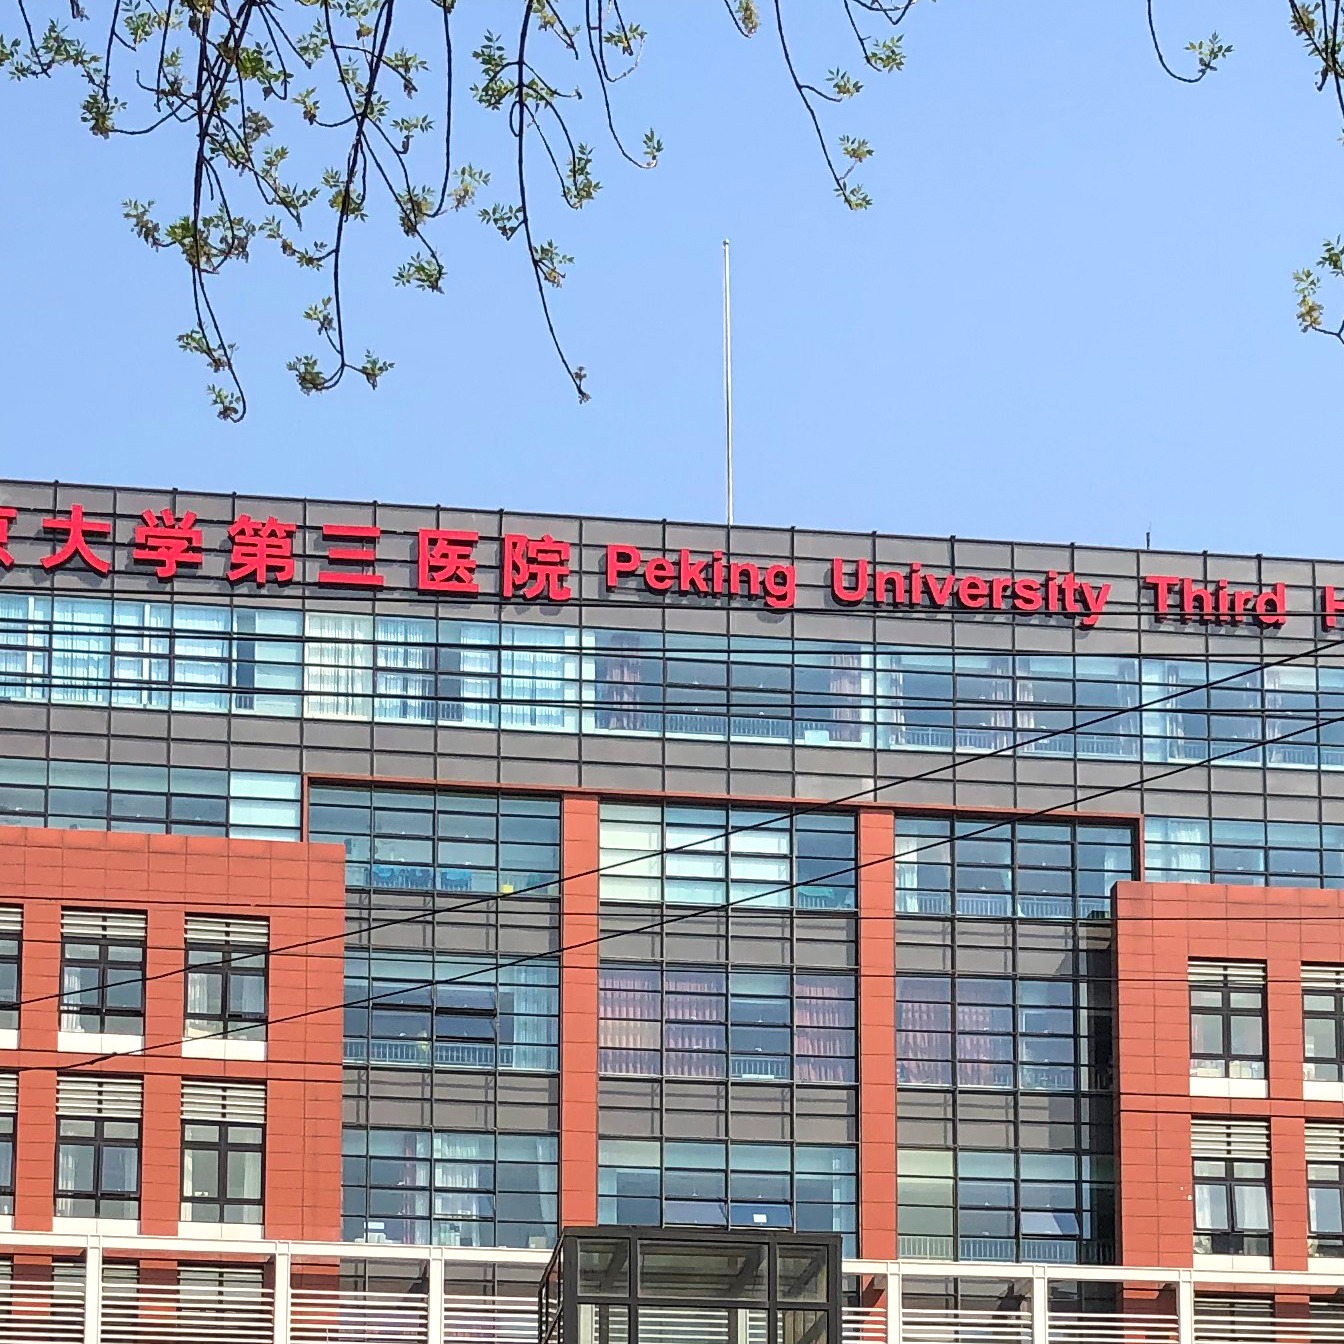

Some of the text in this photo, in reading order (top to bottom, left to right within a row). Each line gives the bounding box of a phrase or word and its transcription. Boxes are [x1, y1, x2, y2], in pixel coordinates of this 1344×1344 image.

[606, 544, 796, 610] Peking
[833, 557, 1111, 627] University
[1146, 574, 1286, 628] Third
